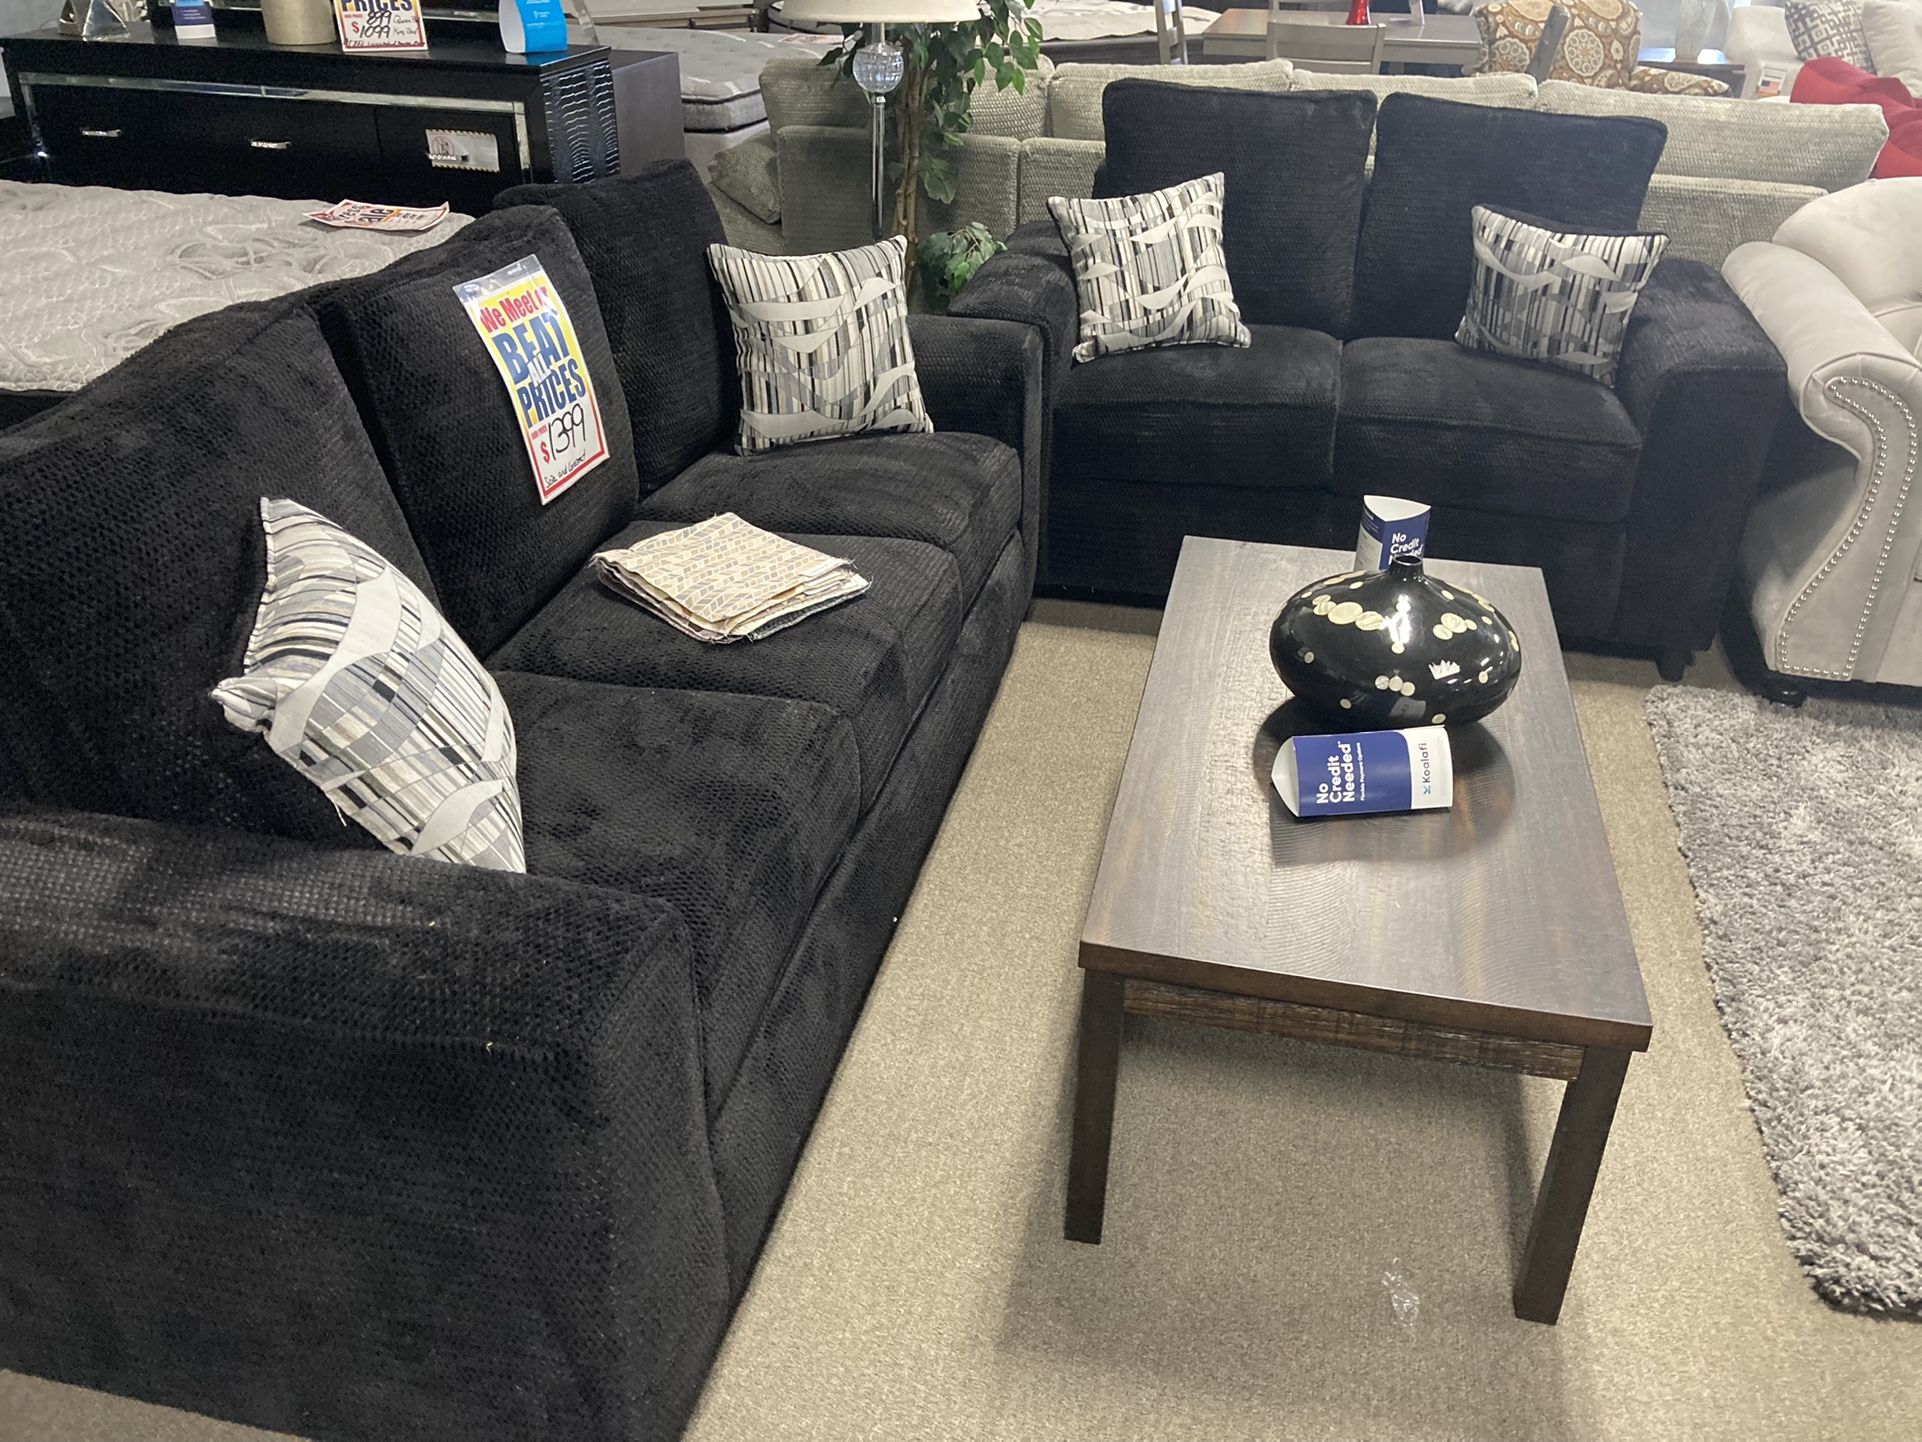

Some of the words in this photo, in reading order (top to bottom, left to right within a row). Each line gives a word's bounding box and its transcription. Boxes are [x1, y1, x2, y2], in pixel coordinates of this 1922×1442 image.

[480, 307, 506, 334] We
[498, 291, 539, 323] Meet
[491, 308, 570, 385] BEAT
[527, 353, 552, 387] ALL
[516, 358, 586, 428] PRICES
[1390, 538, 1420, 554] Credit
[1391, 532, 1407, 544] No
[1327, 755, 1342, 803] Credit
[1418, 742, 1431, 784] Koalafi
[1316, 783, 1329, 804] No
